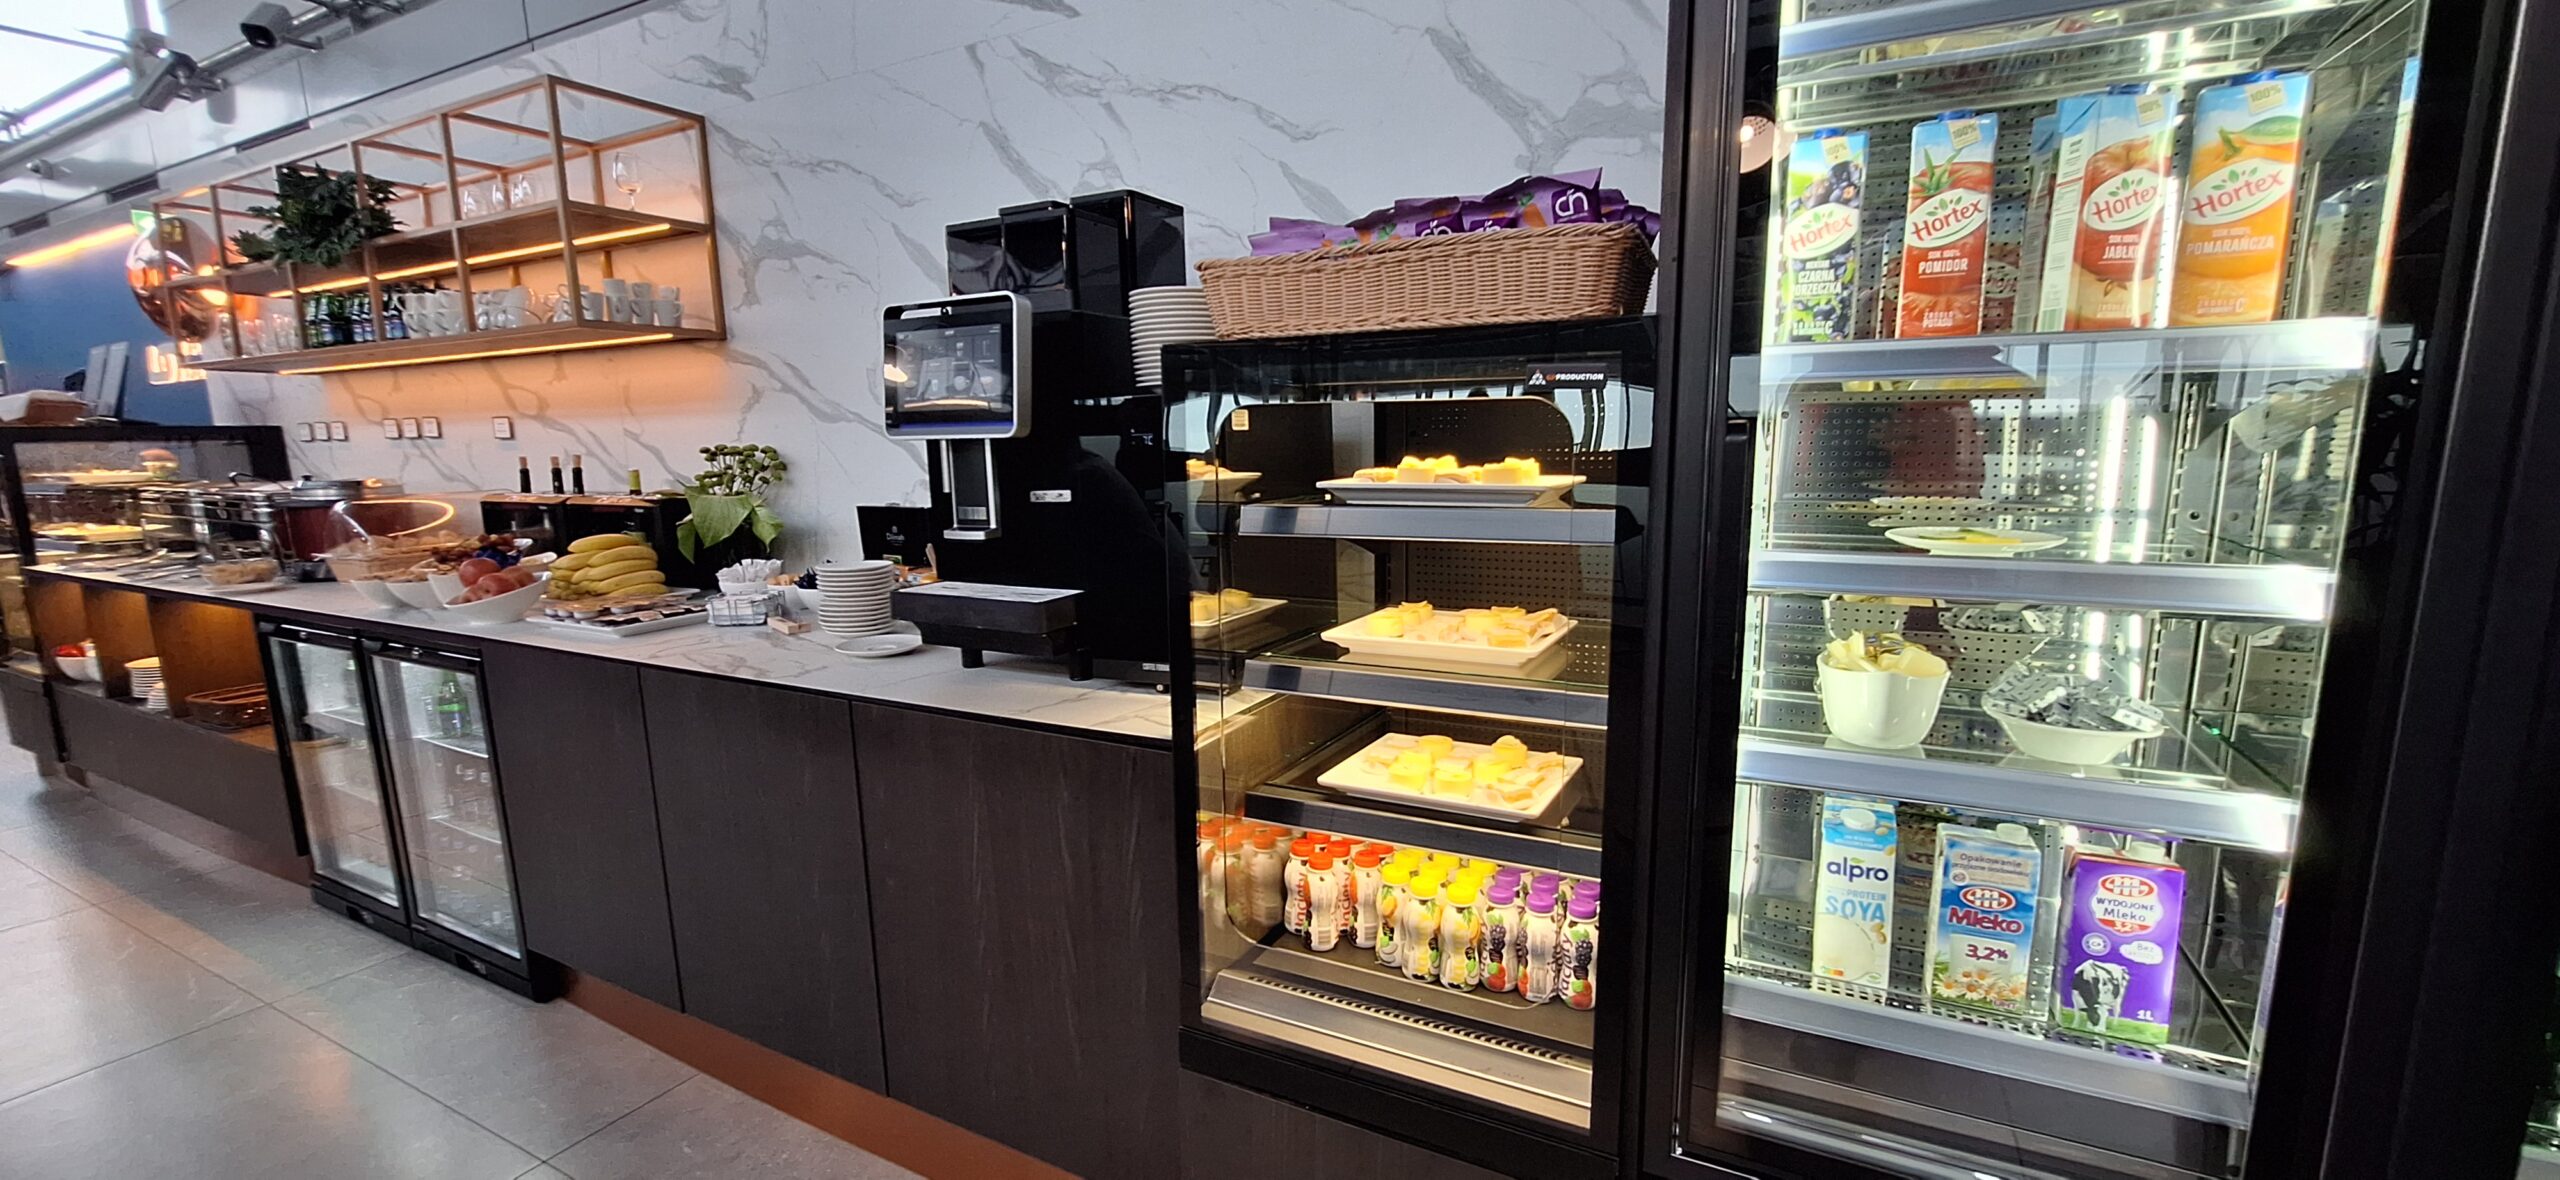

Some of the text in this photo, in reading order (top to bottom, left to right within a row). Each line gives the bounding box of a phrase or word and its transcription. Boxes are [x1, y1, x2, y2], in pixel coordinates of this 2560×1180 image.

[2190, 169, 2285, 219] Hortex
[1911, 199, 1985, 241] Hortex
[1790, 214, 1853, 253] Hortex
[2185, 235, 2275, 256] POMARAŃCZA
[1798, 268, 1836, 284] CZARNA
[1918, 258, 1969, 275] POMIDOR
[1826, 856, 1889, 883] alpro
[1825, 895, 1886, 923] SOYA
[2095, 897, 2155, 911] WYDOJONE
[2103, 907, 2146, 922] Mleko
[1948, 907, 2023, 934] Mleko
[1965, 943, 2009, 961] 3,2%
[2136, 1009, 2154, 1021] 1L
